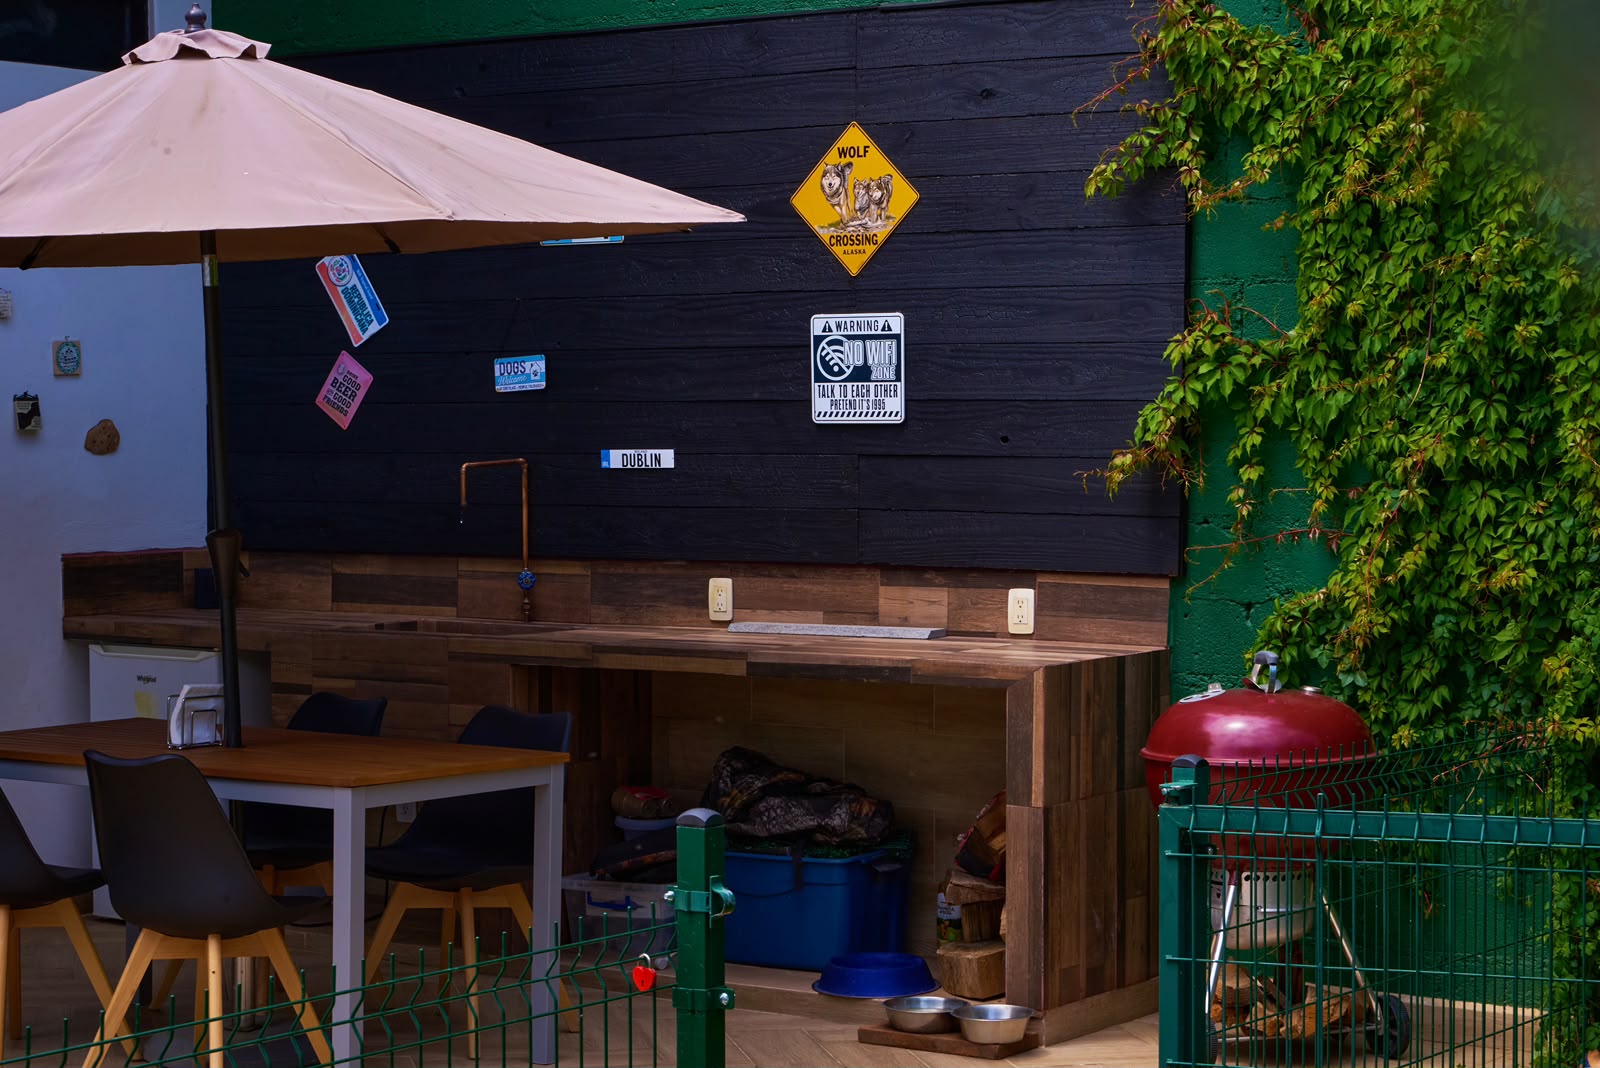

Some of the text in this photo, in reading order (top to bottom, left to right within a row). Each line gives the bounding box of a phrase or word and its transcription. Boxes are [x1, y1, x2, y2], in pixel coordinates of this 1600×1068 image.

[837, 146, 870, 159] WOLF
[829, 233, 878, 247] CROSSING
[341, 286, 368, 335] DOMINICANA
[350, 284, 374, 327] REPUBLICA
[835, 320, 879, 332] WARNING
[843, 339, 897, 366] NO WIFI
[499, 360, 526, 376] DOGS
[871, 365, 896, 380] ZONE
[330, 377, 357, 402] BEER
[343, 375, 361, 391] GOOD
[818, 384, 898, 398] TALK TO EACH OTHER
[323, 395, 349, 417] FRIENDS
[333, 392, 351, 409] GOOD
[830, 399, 886, 410] PRETEND IT'S 1995
[622, 453, 661, 467] DUBLIN
